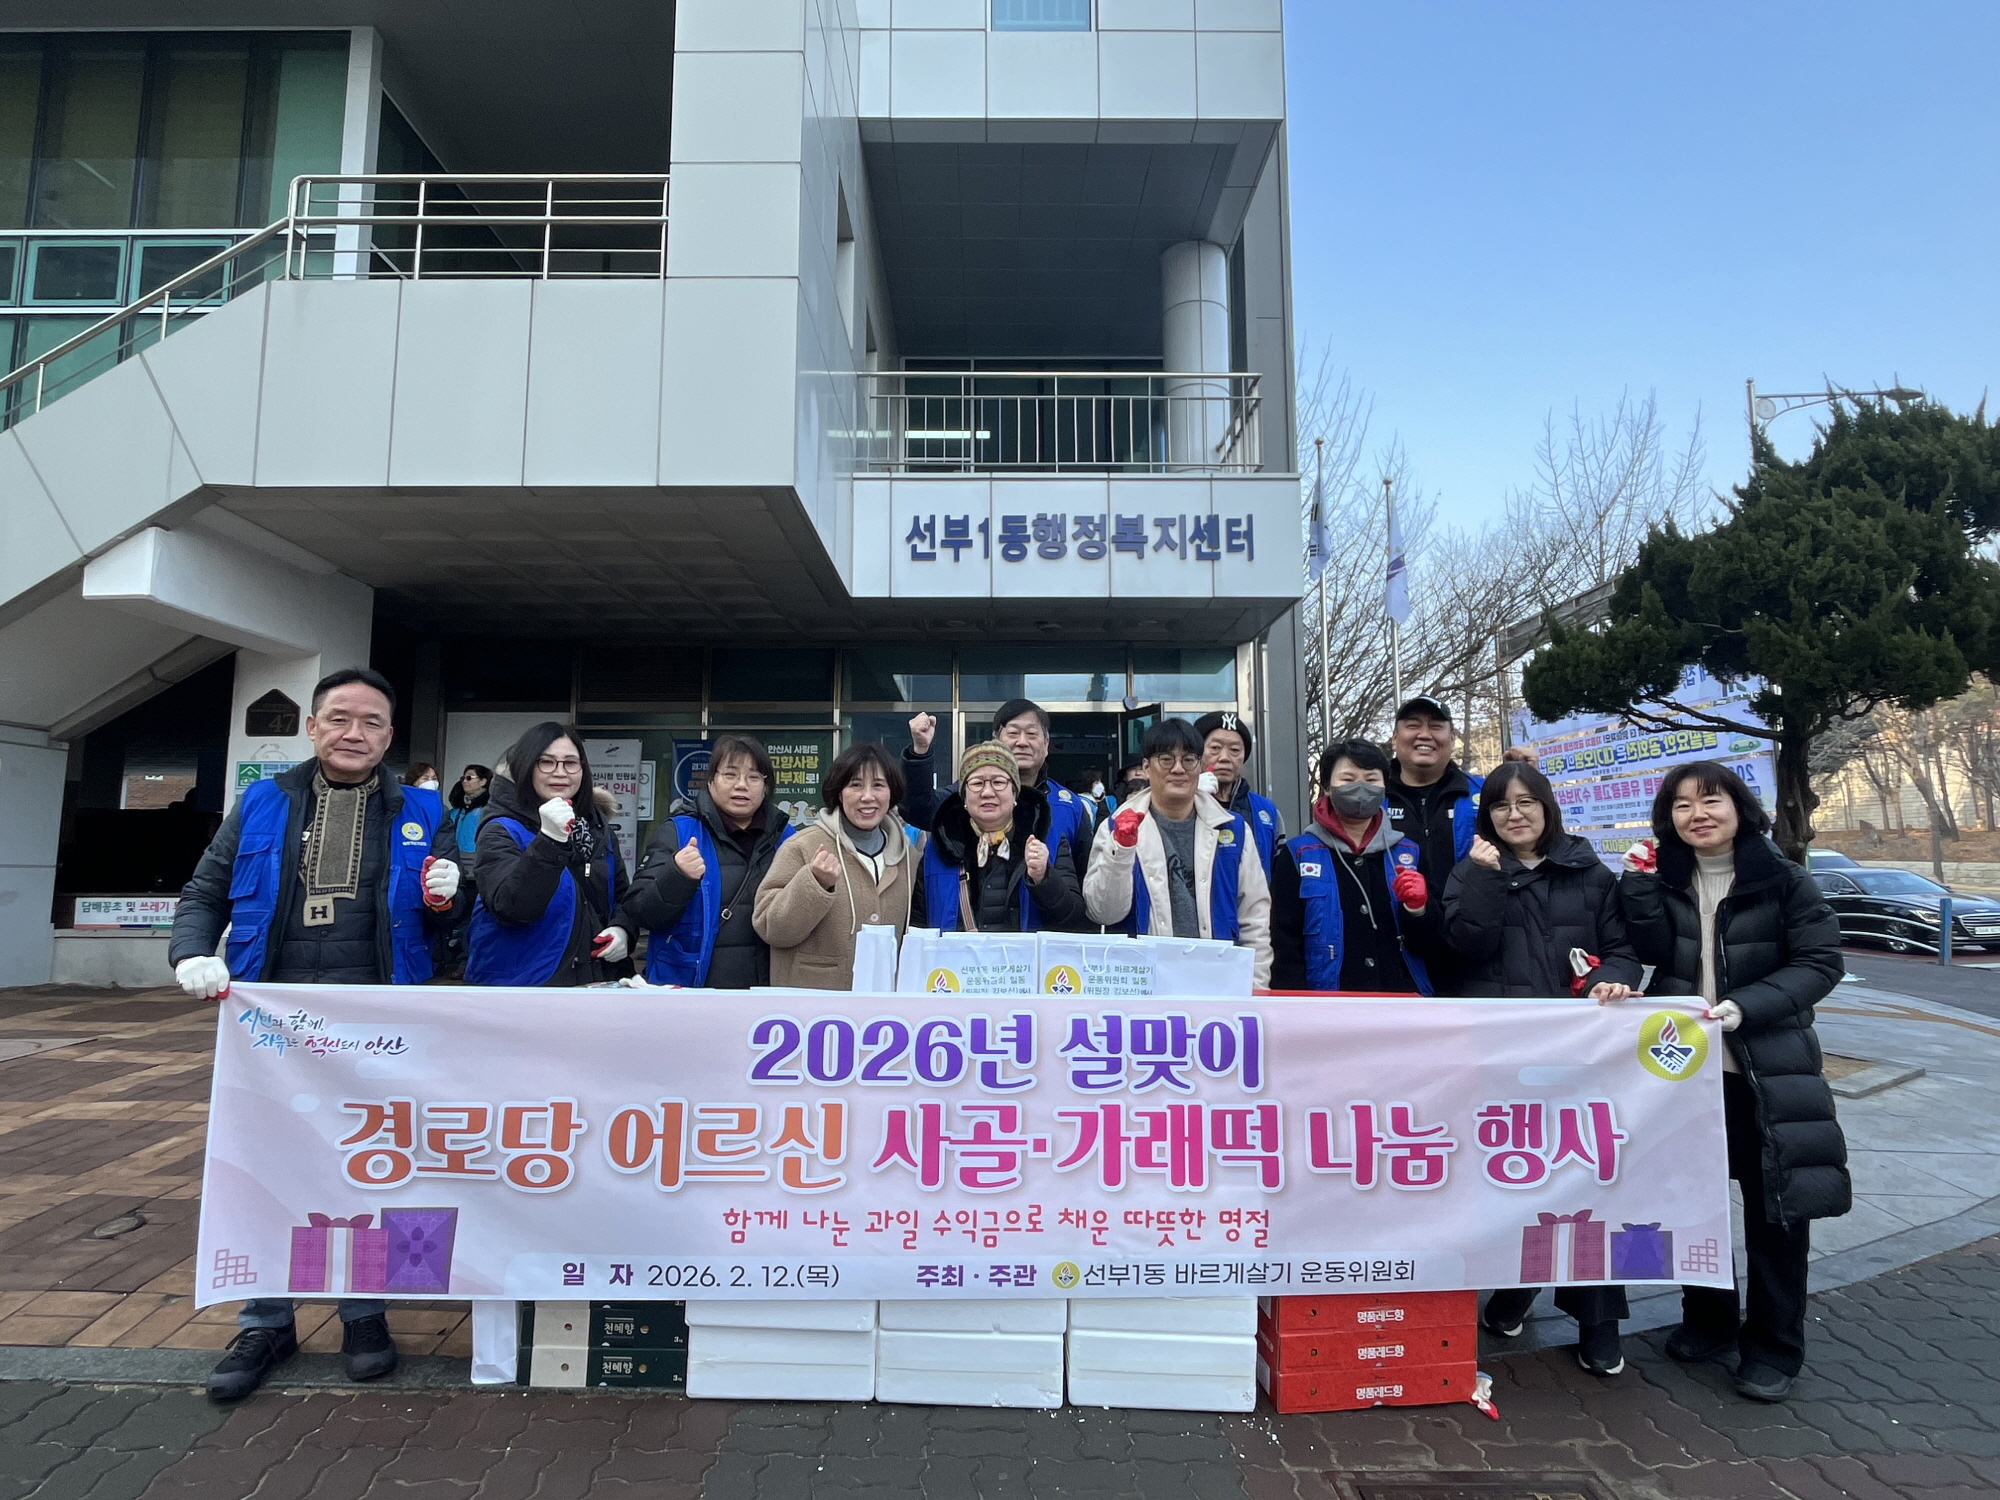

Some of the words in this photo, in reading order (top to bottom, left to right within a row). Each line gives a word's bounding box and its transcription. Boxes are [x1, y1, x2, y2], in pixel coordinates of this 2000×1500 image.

[905, 513, 1254, 562] 선부1동행정복지센터
[268, 713, 297, 733] 47
[1221, 713, 1236, 731] NY
[767, 745, 792, 754] 안산시
[769, 756, 819, 769] 고향사랑
[592, 772, 613, 781] 산시청
[613, 782, 636, 795] 안내
[82, 901, 122, 914] 담배꽁초
[126, 901, 136, 913] 및
[139, 901, 170, 913] 쓰레기
[310, 905, 328, 920] H
[992, 964, 1031, 974] 바르게살기
[1114, 965, 1154, 975] 바르게살기
[1010, 975, 1026, 985] 일동
[1088, 976, 1128, 985] 운동위원회
[1132, 977, 1148, 986] 일동
[1083, 986, 1110, 995] (위원장
[364, 1035, 410, 1056] 안산
[750, 1013, 1036, 1090] 2026년
[1060, 1014, 1262, 1090] 설맞이
[337, 1101, 583, 1188] 경로당
[607, 1101, 844, 1189] 어르신
[873, 1102, 1280, 1189] 사골·가래떡
[1307, 1102, 1455, 1187] 나눔
[1476, 1101, 1628, 1184] 행사
[723, 1207, 788, 1244] 함께
[802, 1208, 850, 1247] 나눈
[865, 1208, 919, 1250] 과일
[933, 1204, 1045, 1249] 수익금으로
[1057, 1206, 1109, 1246] 채운
[1123, 1207, 1207, 1248] 따뜻한
[1219, 1208, 1270, 1249] 명절
[561, 1262, 586, 1286] 일
[609, 1263, 634, 1286] 자
[647, 1264, 722, 1288] 2026.
[729, 1265, 752, 1288] 2.
[762, 1264, 841, 1289] 12.(목)
[916, 1265, 964, 1288] 주최
[988, 1264, 1037, 1288] 주관
[1083, 1262, 1166, 1286] 선부1동
[1175, 1262, 1293, 1285] 바르게살기
[1300, 1259, 1417, 1283] 운동위원회
[1357, 1309, 1404, 1323] 명품레드향
[604, 1322, 635, 1335] 천혜향
[1358, 1345, 1405, 1360] 명품레드향
[602, 1361, 633, 1374] 천혜향
[1356, 1384, 1403, 1399] 명품레드향
